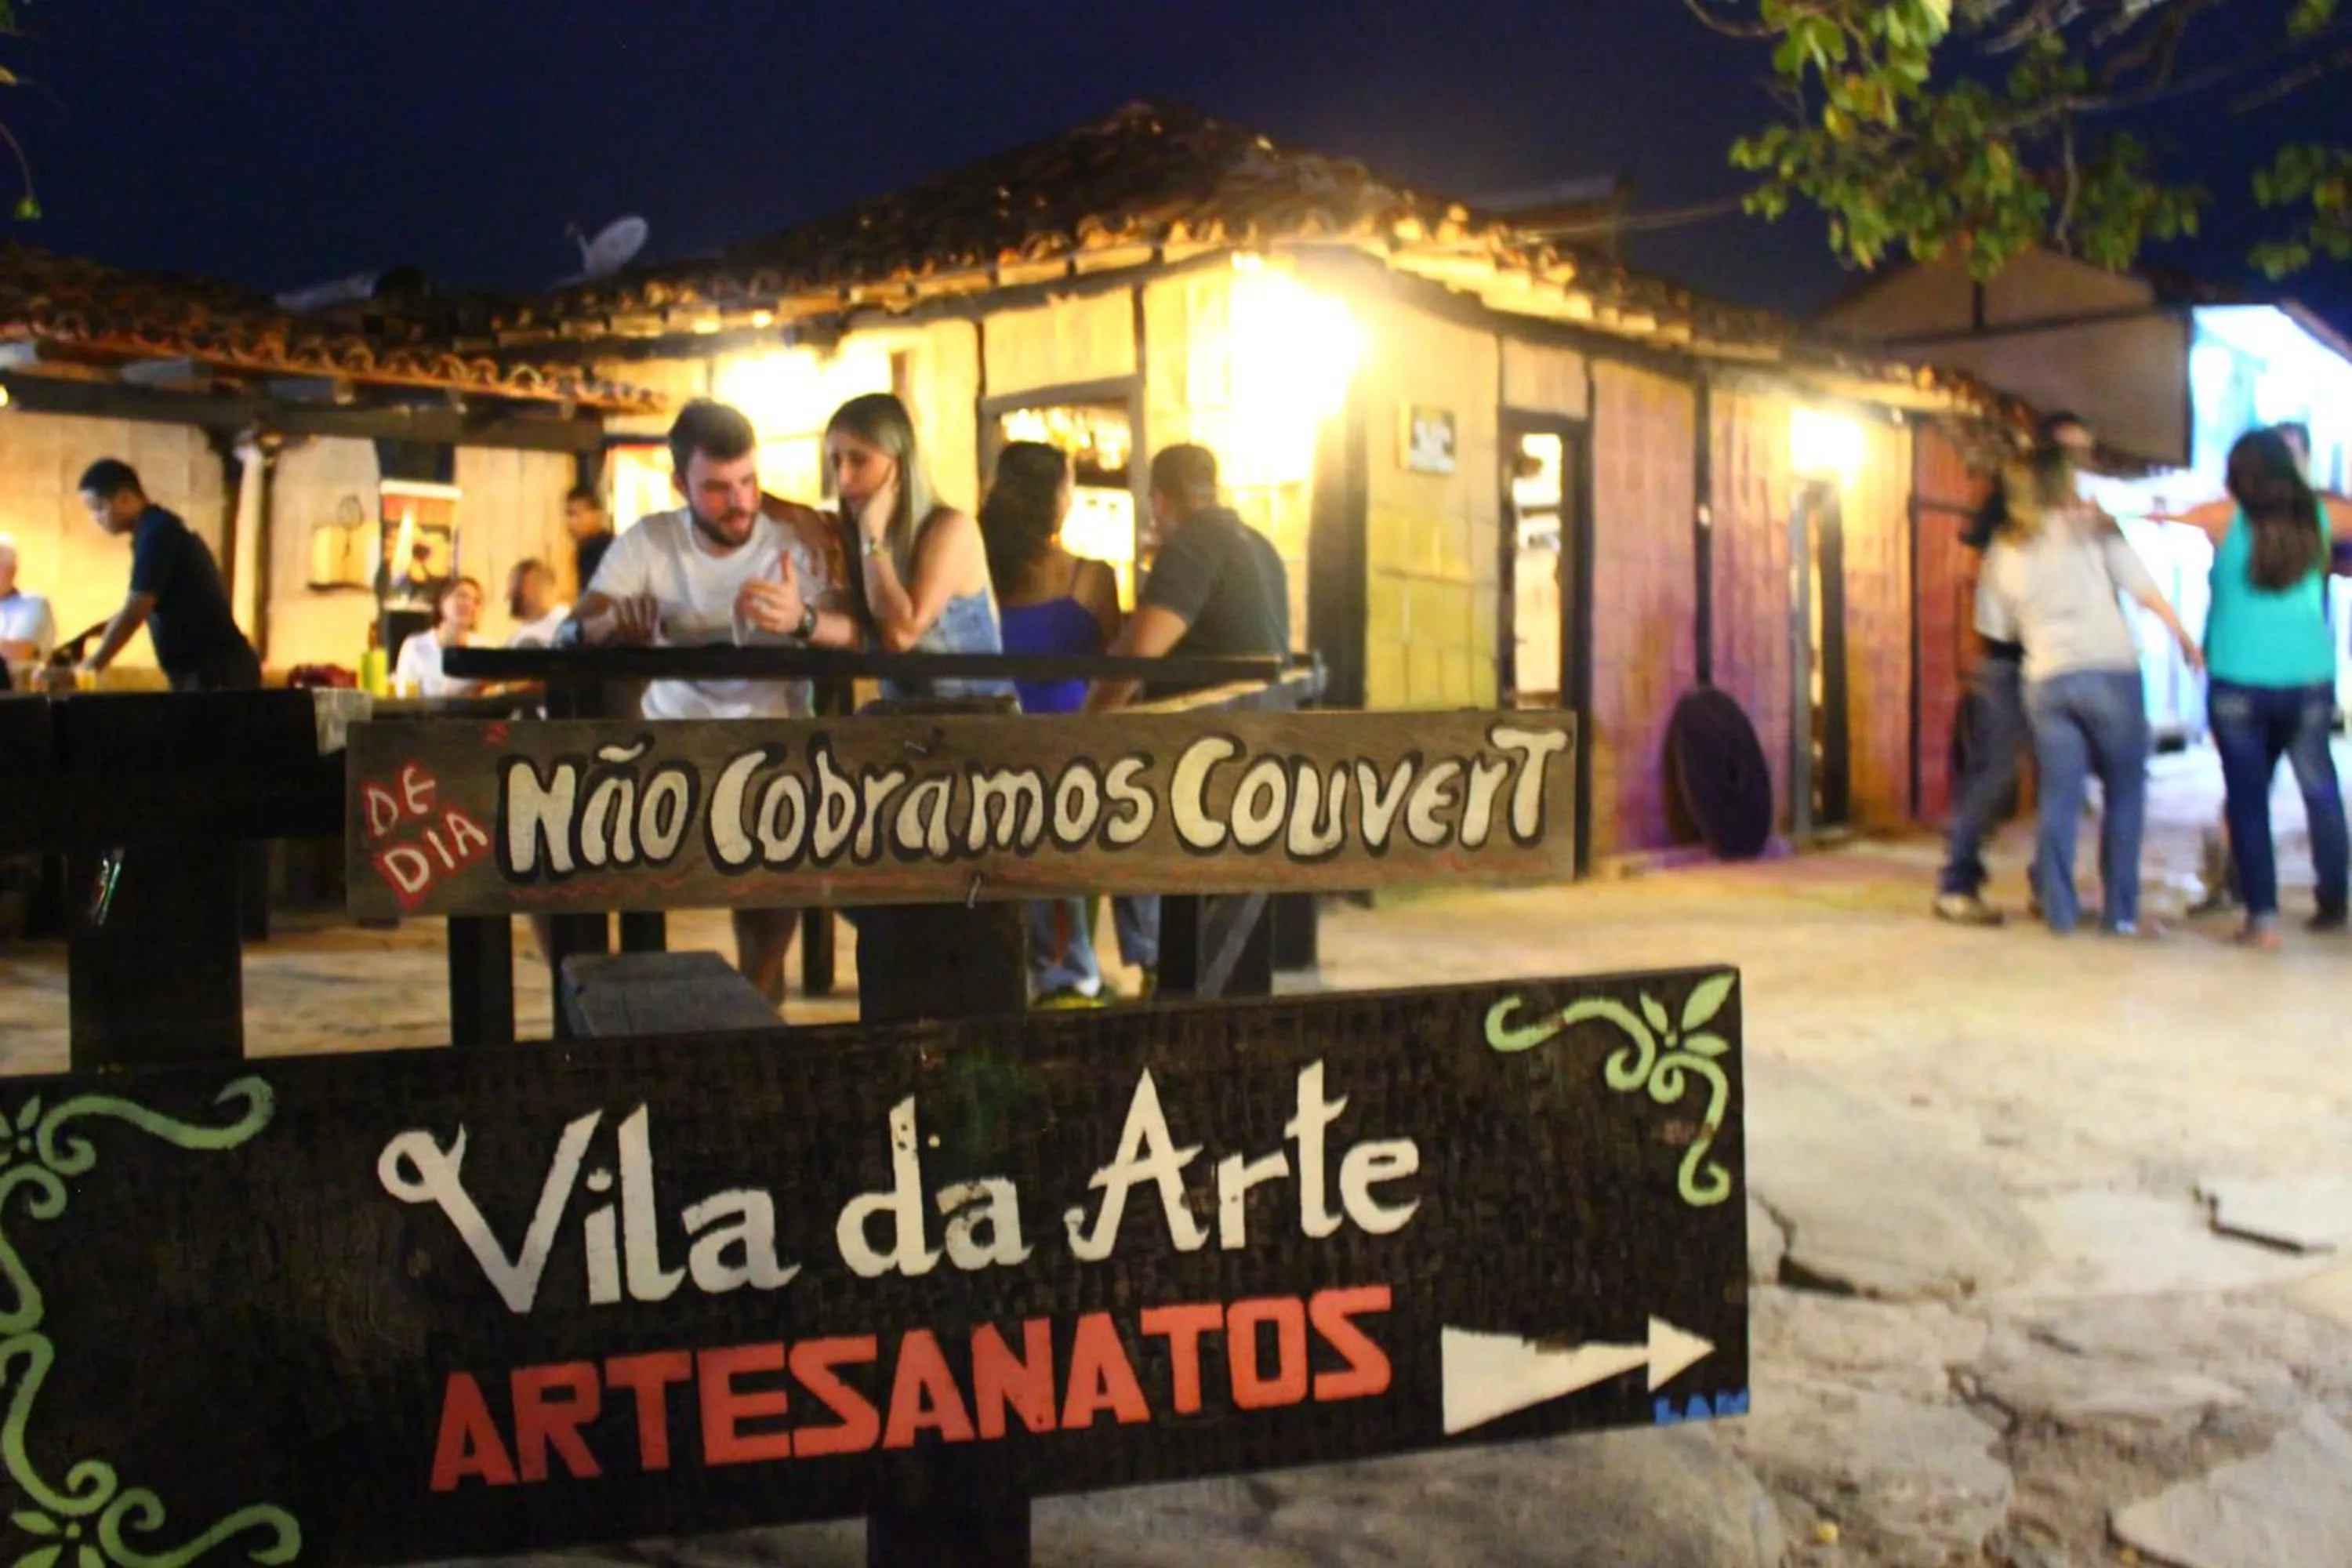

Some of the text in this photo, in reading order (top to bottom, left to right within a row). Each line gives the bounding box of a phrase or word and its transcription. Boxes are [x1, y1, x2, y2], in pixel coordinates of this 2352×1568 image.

[366, 766, 435, 835] DE
[383, 811, 488, 893] DIA
[506, 739, 690, 873] Não
[709, 749, 1154, 864] Cobramos
[376, 1058, 1421, 1312] Vila da Arte
[430, 1285, 1393, 1492] ARTESANATOS
